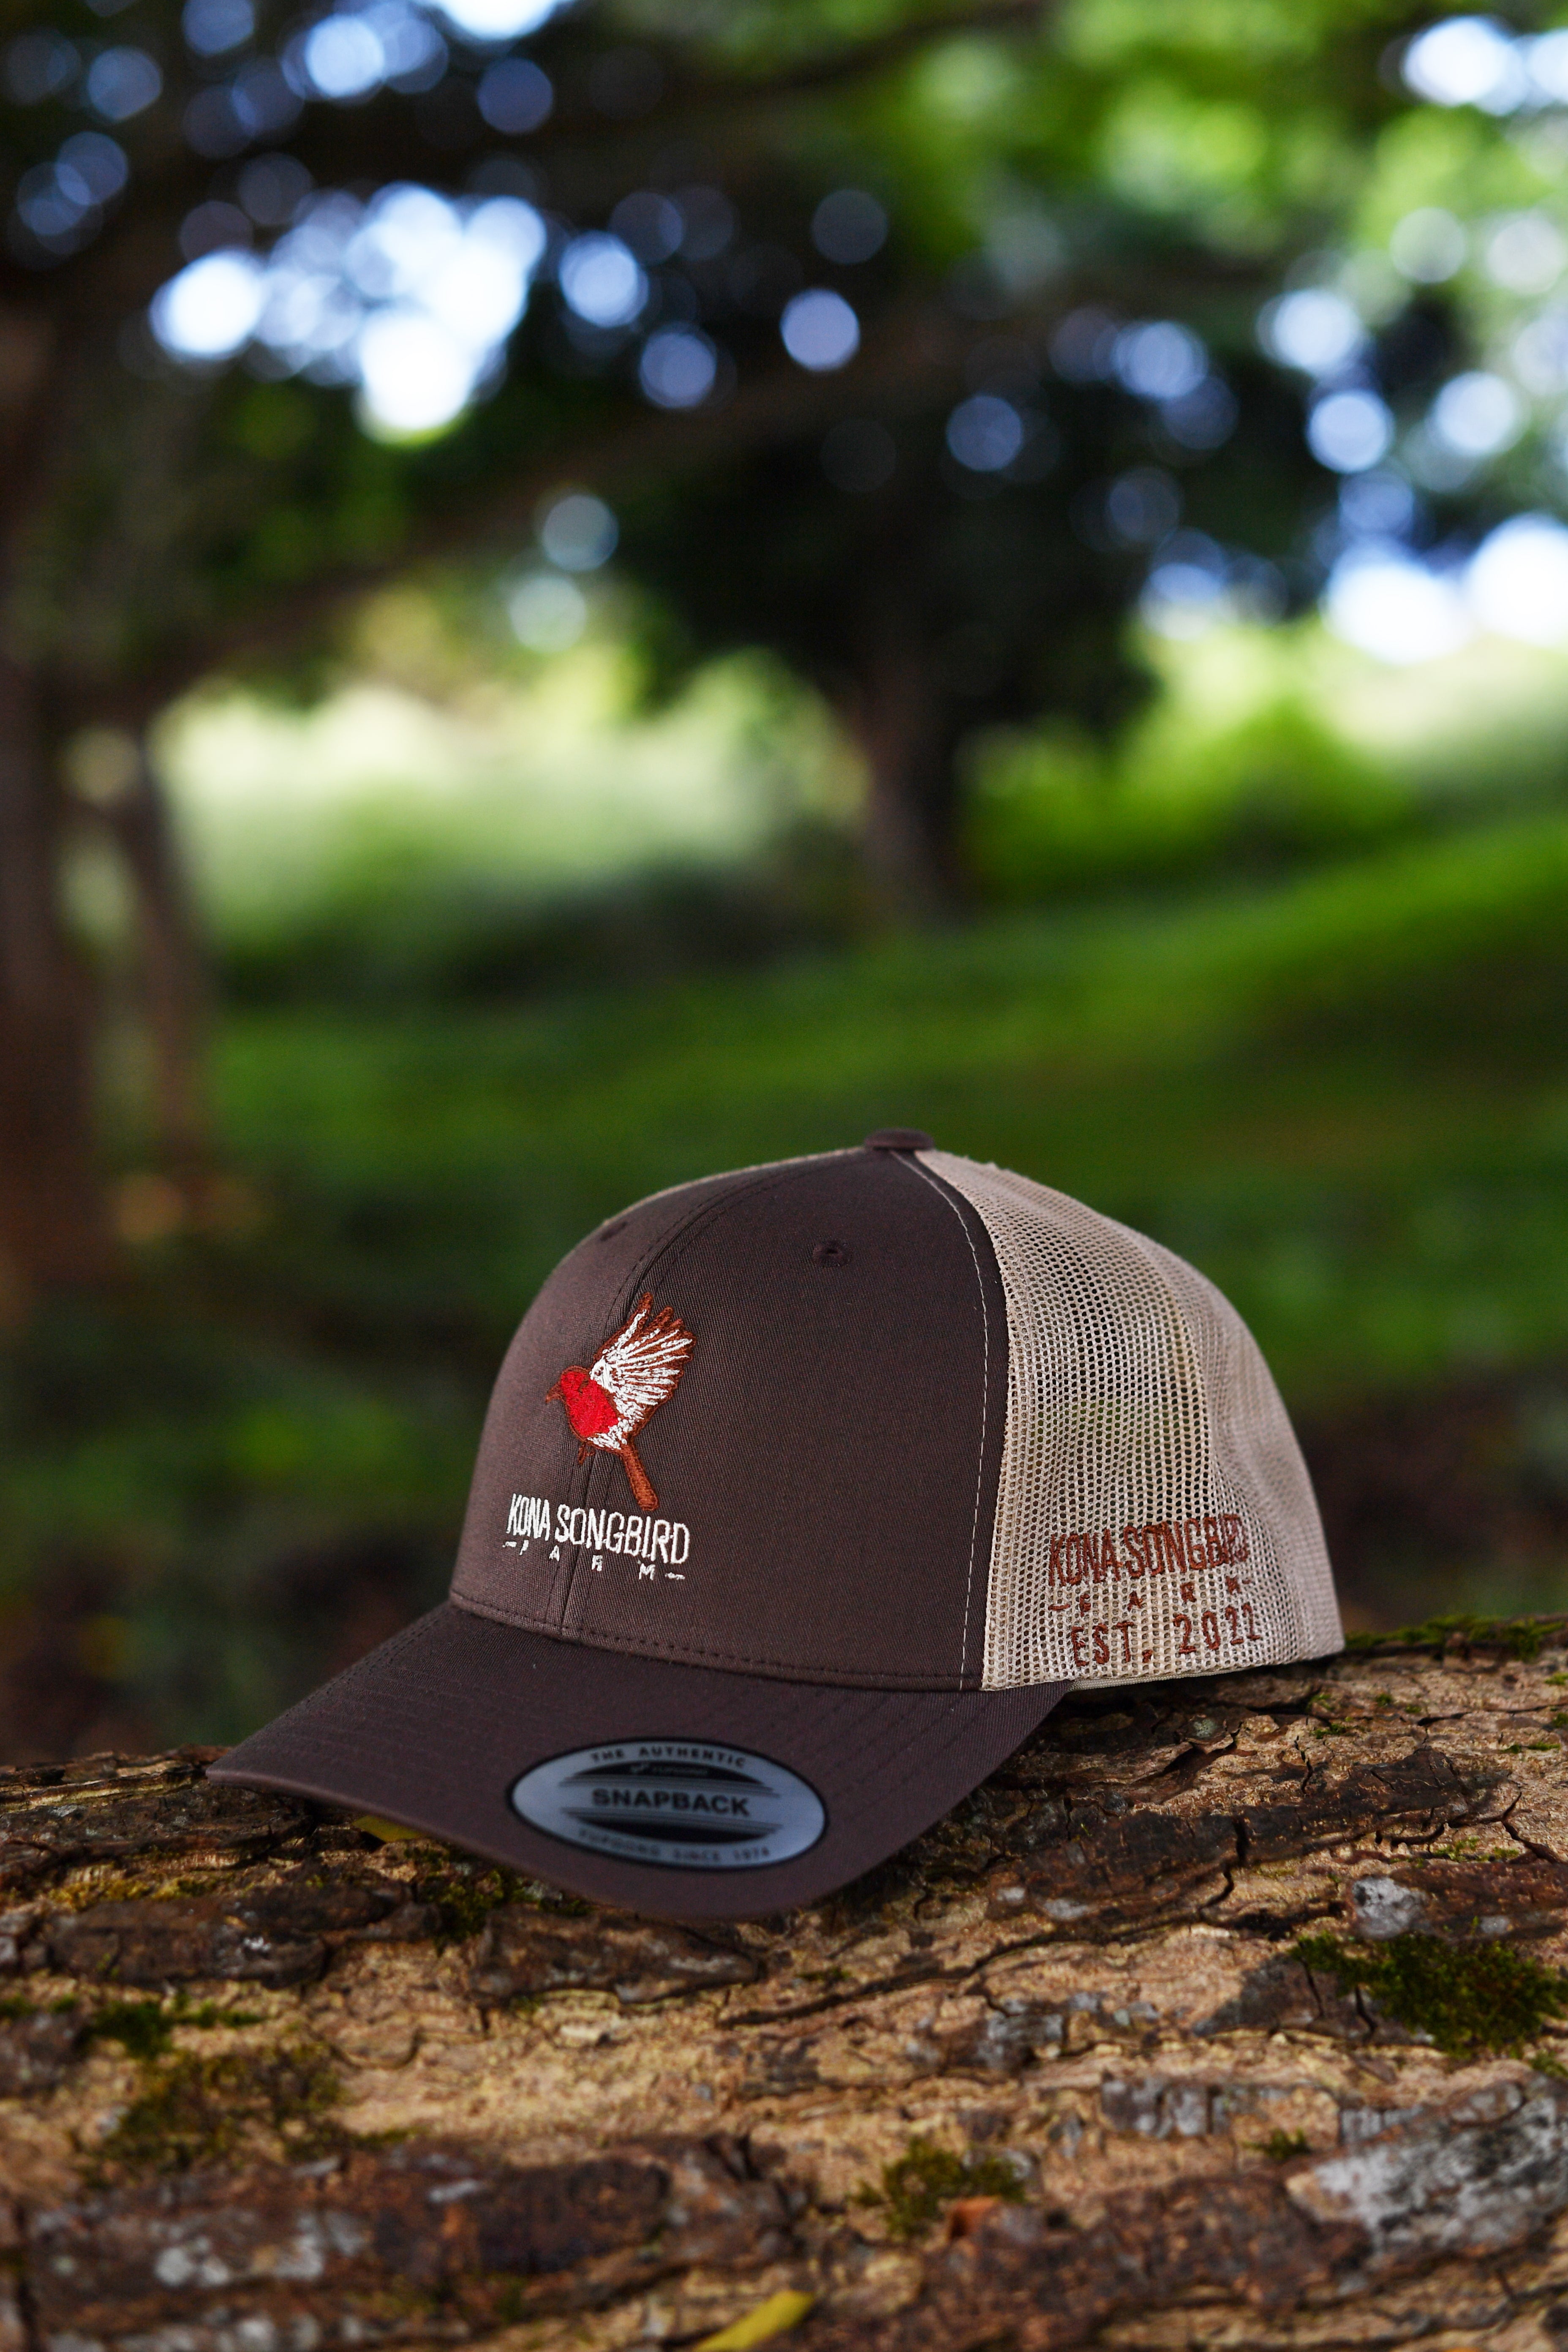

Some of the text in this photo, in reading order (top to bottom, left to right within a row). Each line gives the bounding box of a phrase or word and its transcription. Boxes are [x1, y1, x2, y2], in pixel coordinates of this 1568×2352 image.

[506, 1493, 690, 1564] KONA SONGBIRD
[1049, 1514, 1250, 1586] KONA SONGBIRD
[1071, 1621, 1154, 1666] EST.
[592, 1747, 624, 1762] THE
[640, 1746, 747, 1769] AUTHENTIC
[592, 1789, 750, 1816] SNAPBACK
